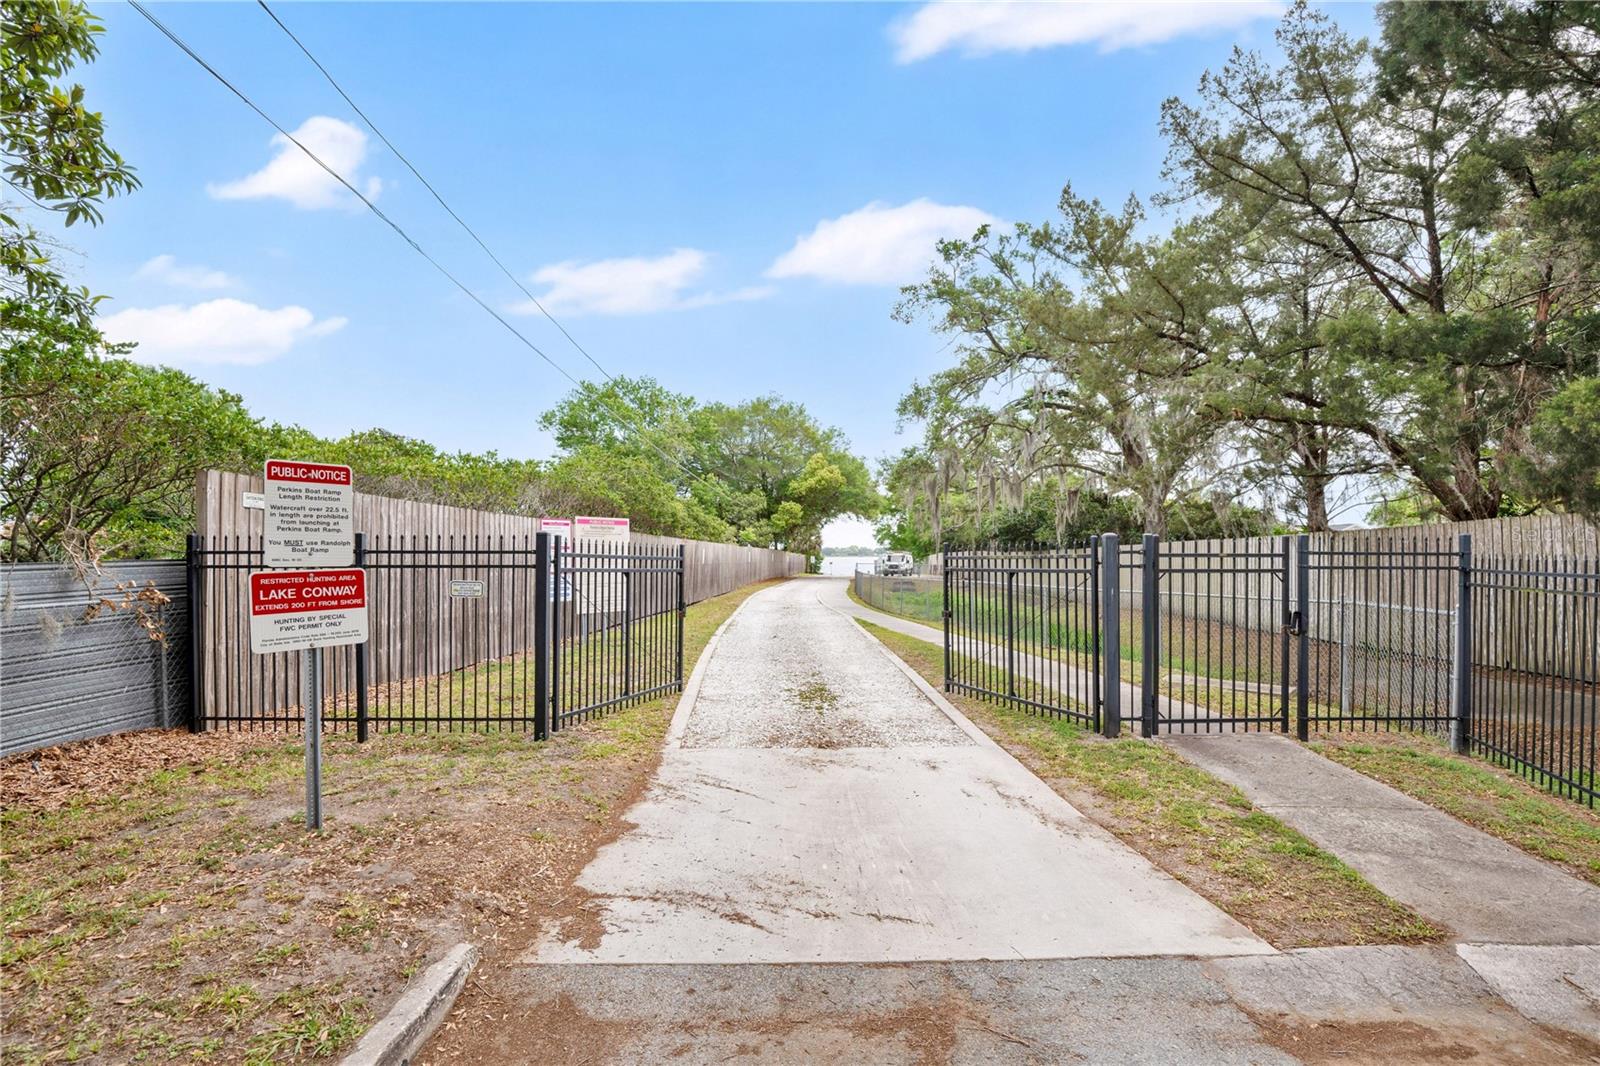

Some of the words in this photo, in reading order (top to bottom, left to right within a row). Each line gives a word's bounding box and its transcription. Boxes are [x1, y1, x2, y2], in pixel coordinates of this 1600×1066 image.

[277, 486, 303, 494] Perkins
[279, 493, 303, 501] Length
[299, 519, 331, 527] launching
[284, 539, 304, 547] MUST
[260, 577, 305, 585] RESTRICTED
[306, 575, 337, 583] HUNTING
[259, 588, 297, 601] LAKE
[302, 585, 358, 599] CONWAY
[255, 603, 289, 611] EXTENDS
[340, 598, 363, 606] SHORE
[274, 616, 306, 625] HUNTING
[319, 613, 347, 621] SPECIAL
[298, 622, 323, 630] PERMIT
[325, 620, 343, 628] ONLY
